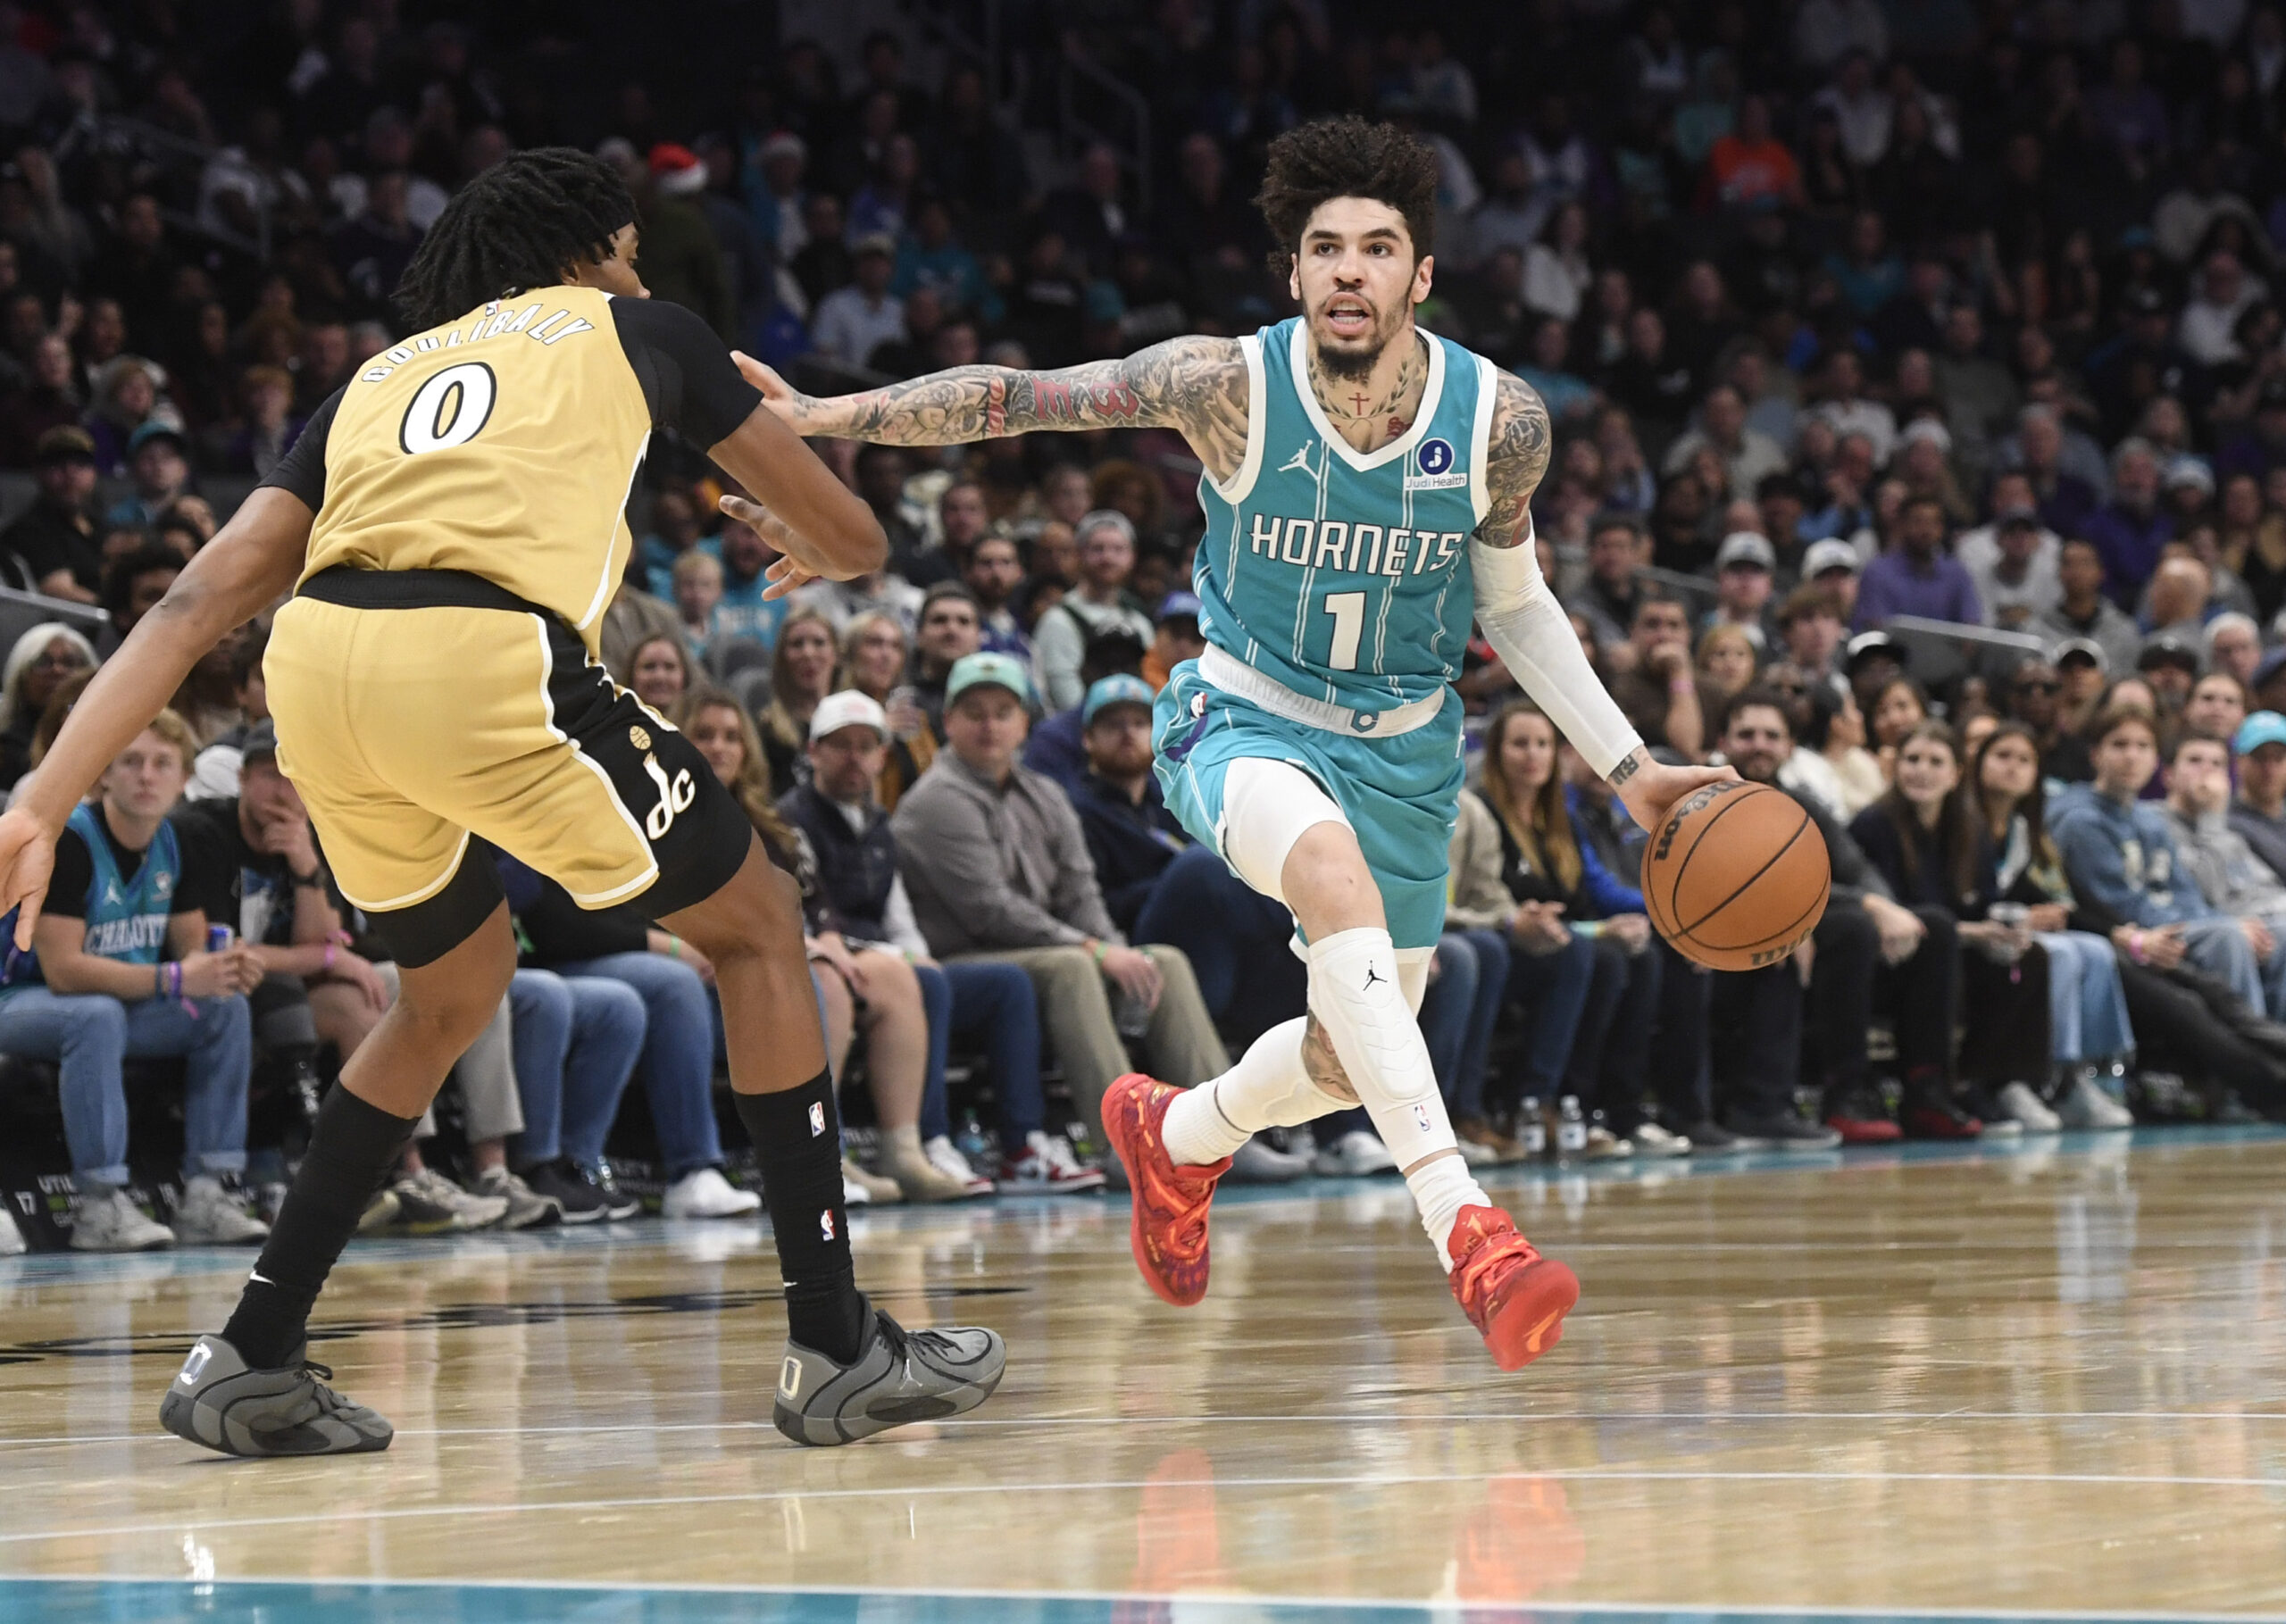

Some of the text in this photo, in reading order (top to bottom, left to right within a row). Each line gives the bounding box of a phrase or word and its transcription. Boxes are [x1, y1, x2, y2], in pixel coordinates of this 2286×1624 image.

[361, 303, 596, 383] COULIBALY
[399, 362, 497, 454] 0
[1406, 476, 1465, 488] Judi Health
[1247, 513, 1464, 577] HORNETS
[1323, 590, 1367, 671] 1
